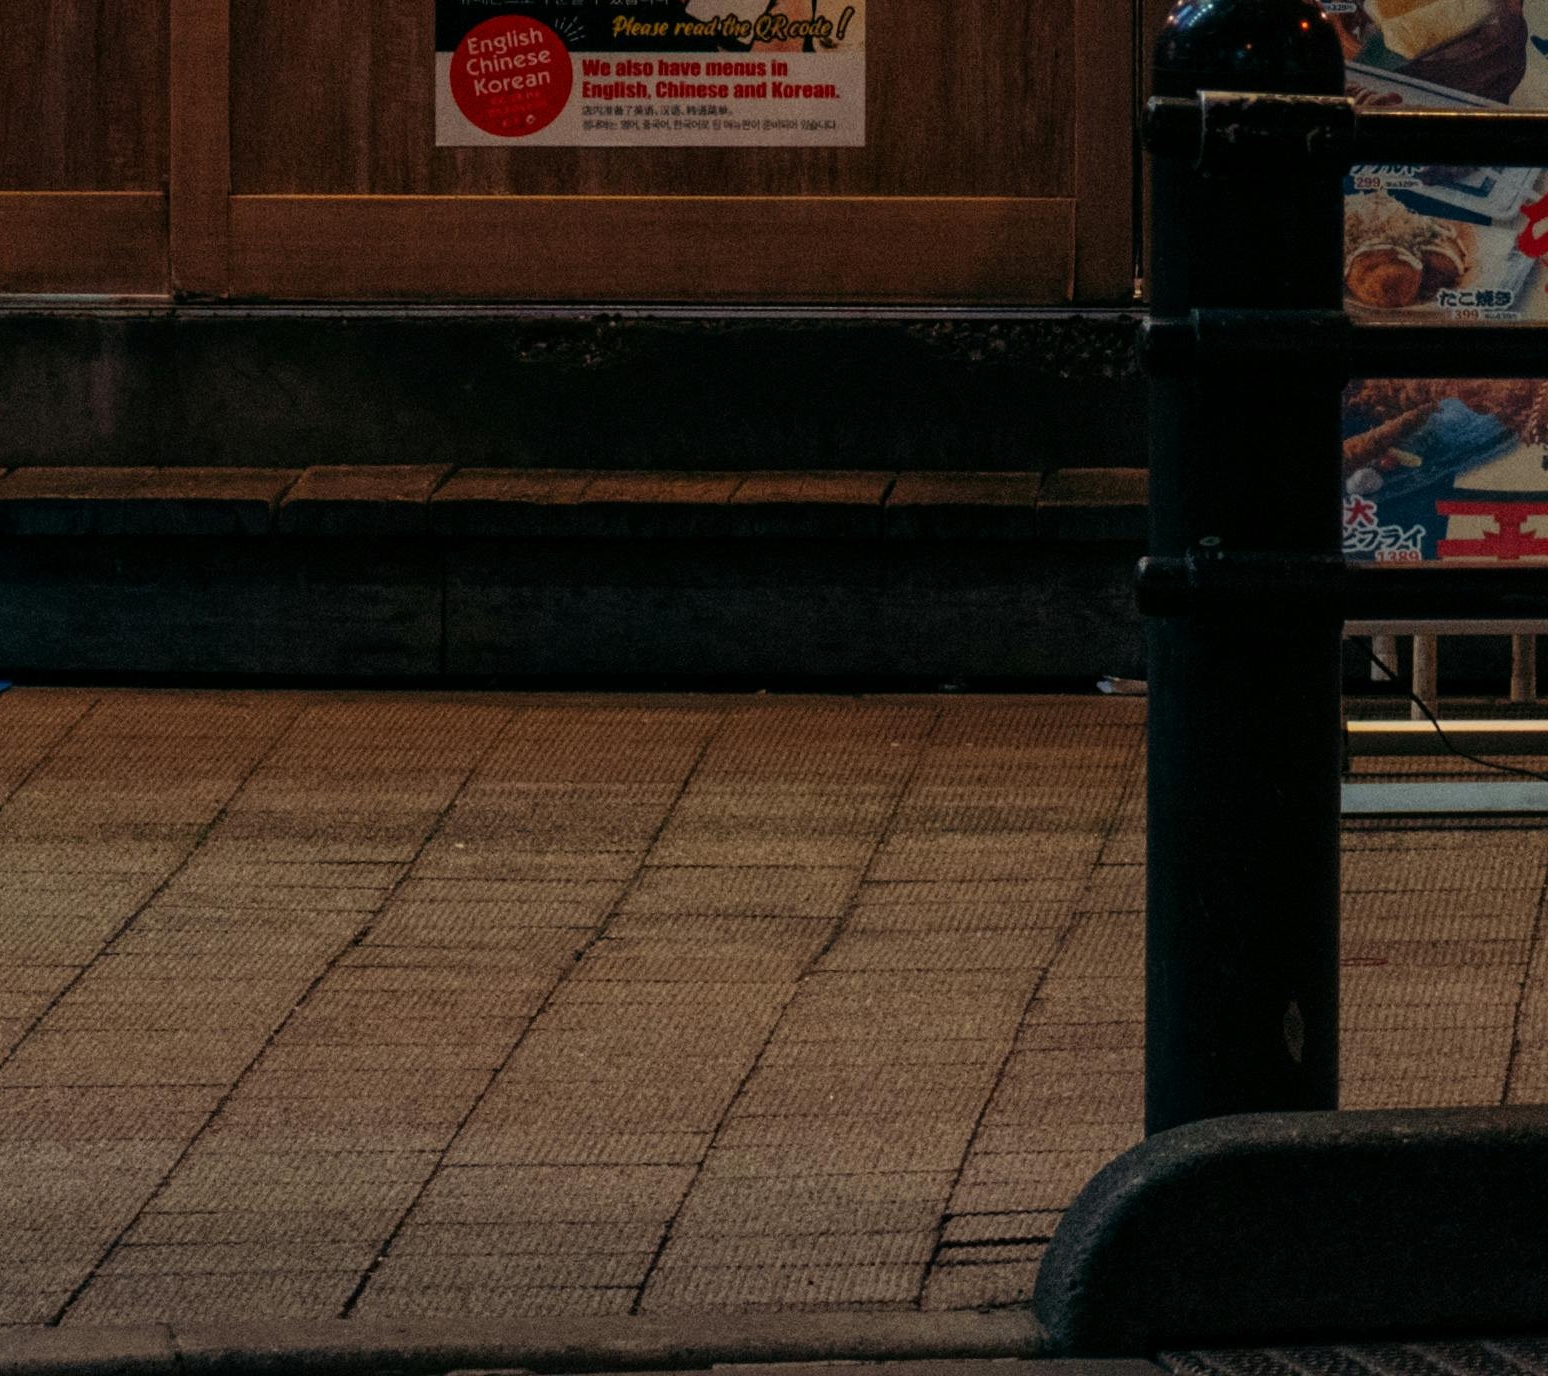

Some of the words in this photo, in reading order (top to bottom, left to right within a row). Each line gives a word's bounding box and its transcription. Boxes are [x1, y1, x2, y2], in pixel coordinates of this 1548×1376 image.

[612, 14, 668, 38] Please
[467, 28, 543, 55] English
[466, 50, 550, 77] Chinese
[583, 60, 609, 75] We
[615, 59, 652, 75] also
[658, 60, 700, 76] have
[706, 61, 766, 76] menus
[772, 60, 788, 75] in
[473, 71, 551, 96] Korean
[656, 82, 729, 98] Chinese
[734, 83, 768, 98] and
[774, 82, 840, 98] Korean.
